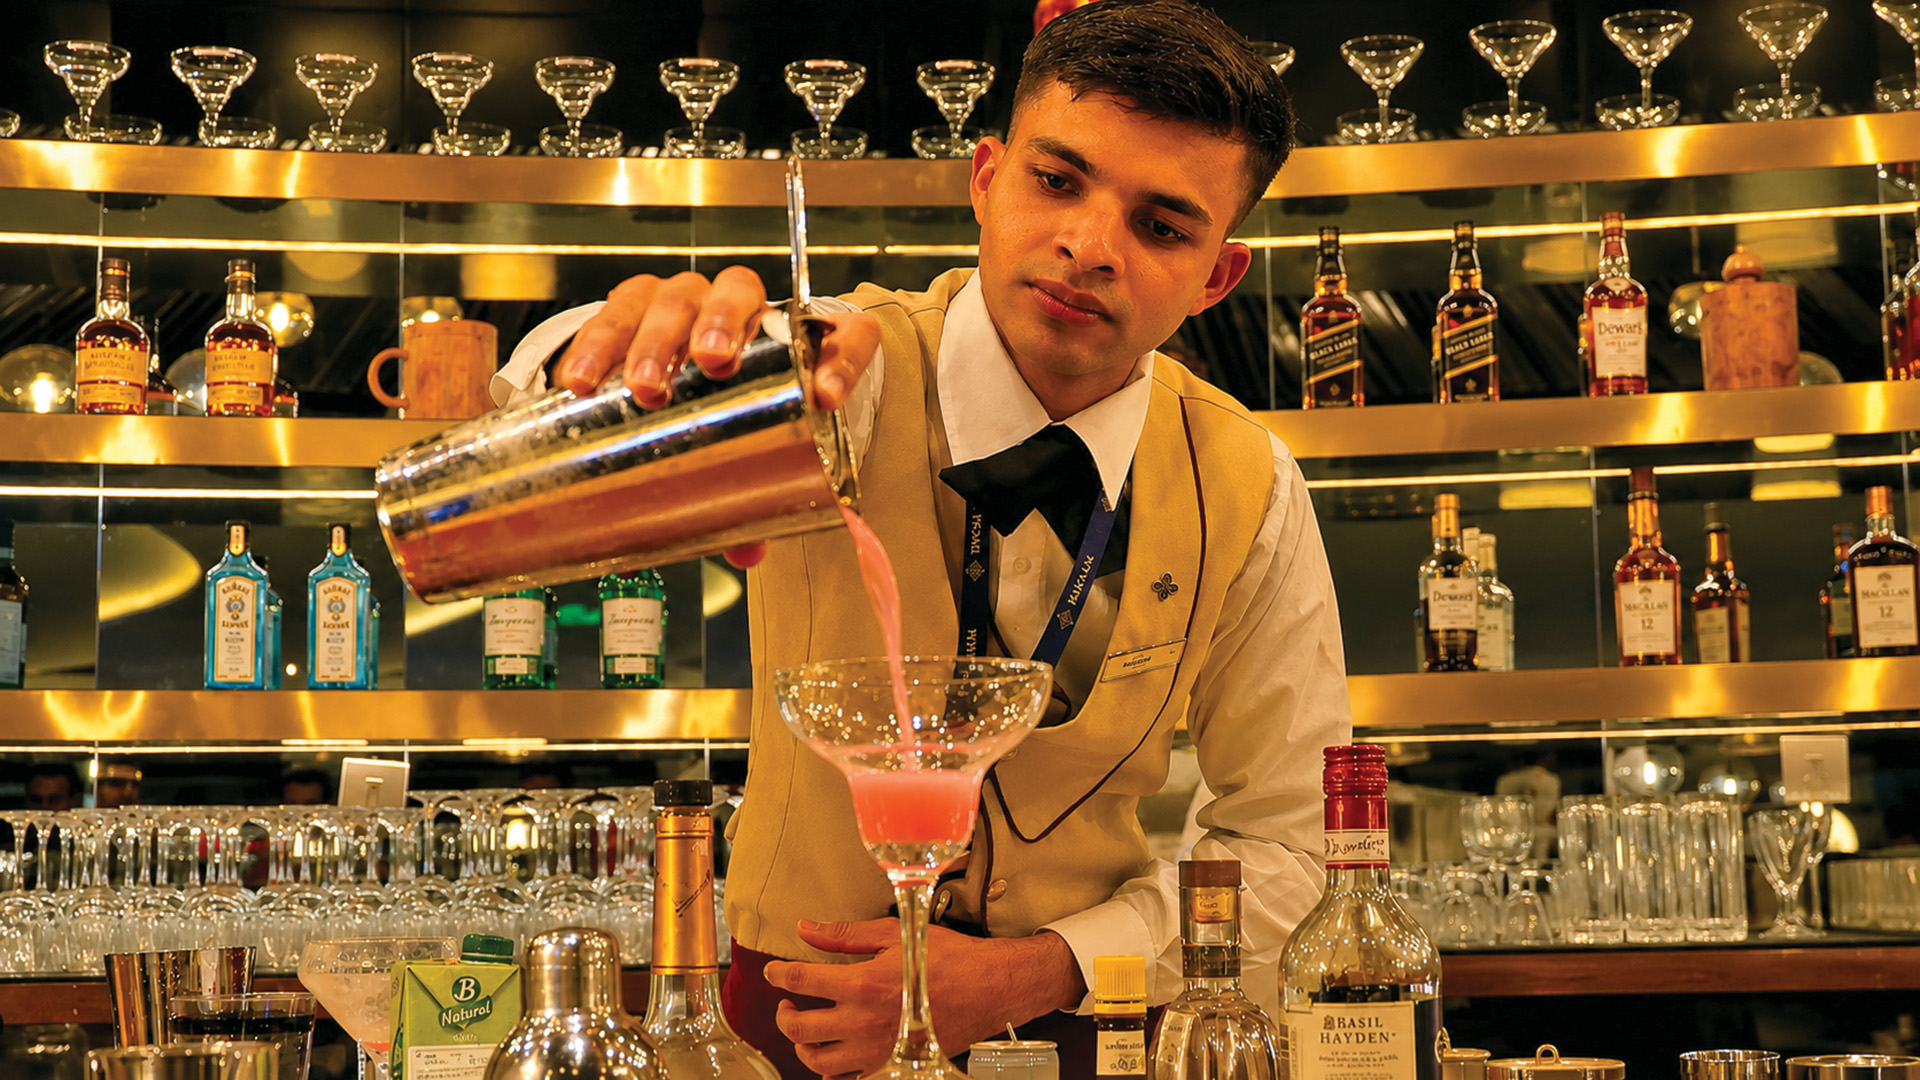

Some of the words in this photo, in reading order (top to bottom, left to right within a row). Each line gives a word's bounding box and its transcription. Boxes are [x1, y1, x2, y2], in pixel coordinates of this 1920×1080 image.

[1879, 605, 1894, 618] 12
[453, 978, 476, 1001] B
[441, 1000, 491, 1027] Natural
[1337, 1017, 1384, 1029] BASIL
